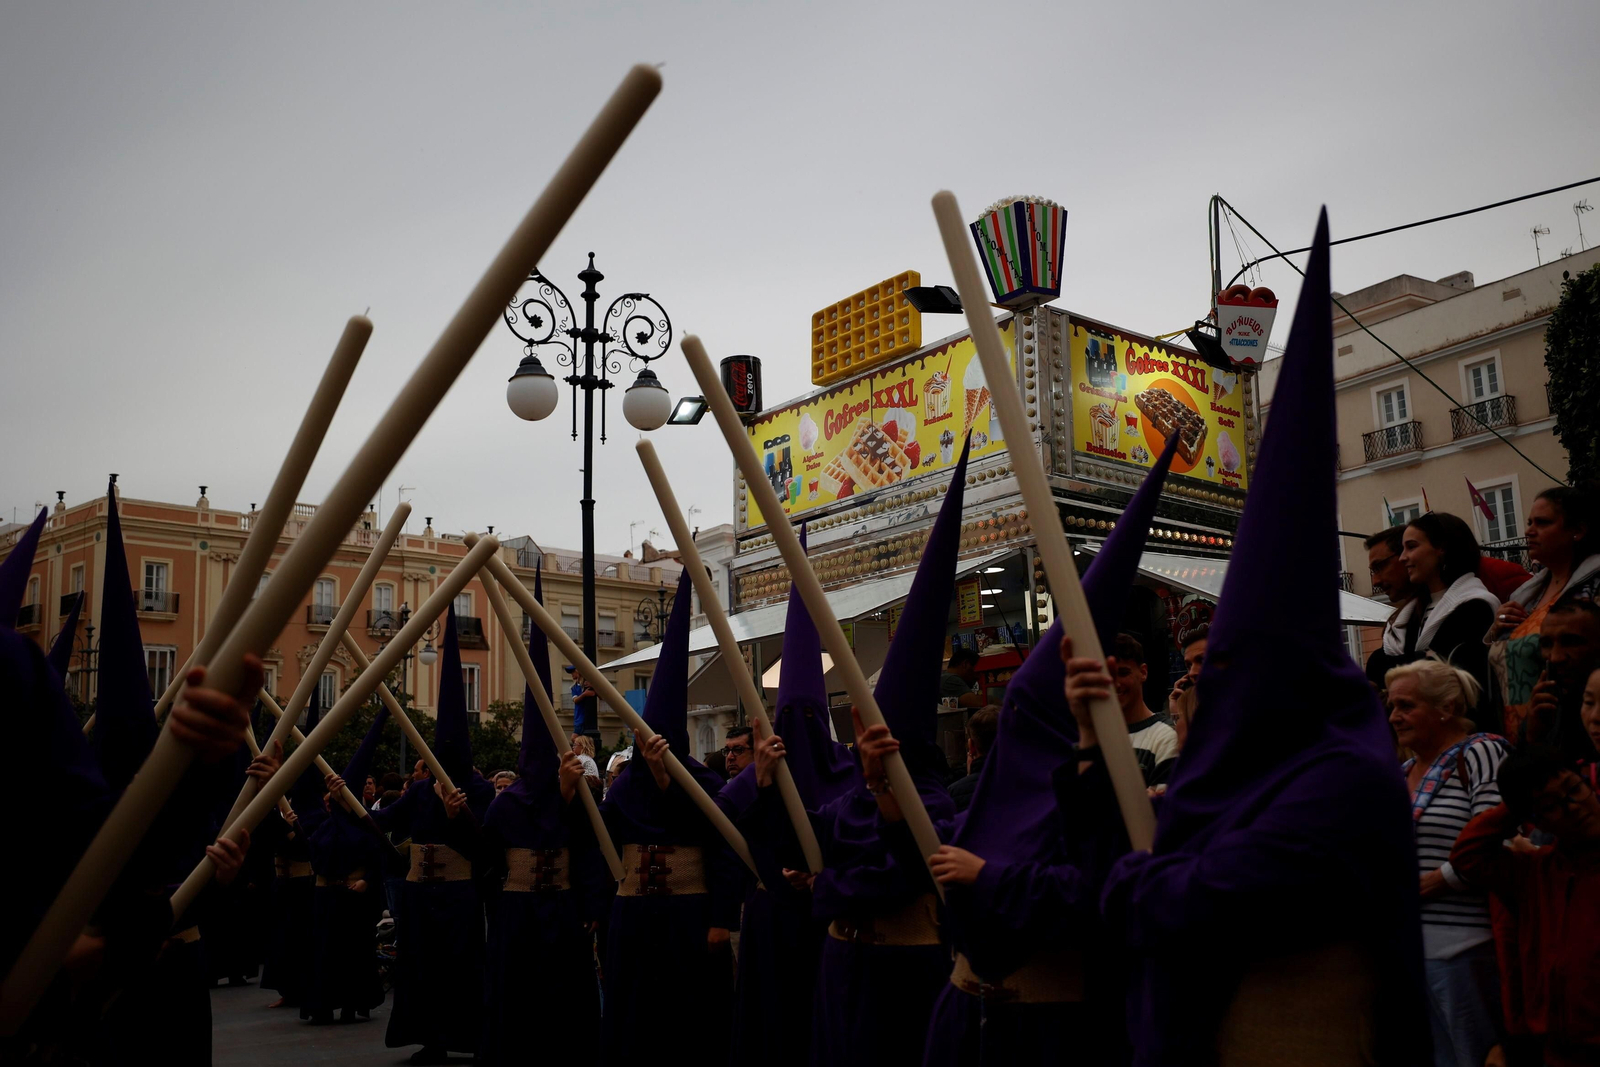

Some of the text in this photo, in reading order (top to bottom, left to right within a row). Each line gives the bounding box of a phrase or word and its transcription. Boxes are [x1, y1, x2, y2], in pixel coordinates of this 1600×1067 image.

[975, 221, 1023, 286] PALOMITAS
[1226, 315, 1264, 336] BUÑUELOS
[1229, 338, 1258, 347] ATRACCIONES
[1125, 348, 1209, 394] Gofres XXXL
[824, 377, 918, 440] Gofres XXXL
[1210, 402, 1240, 418] Helados
[1218, 416, 1235, 428] Soft
[1086, 441, 1127, 460] Buñuelos
